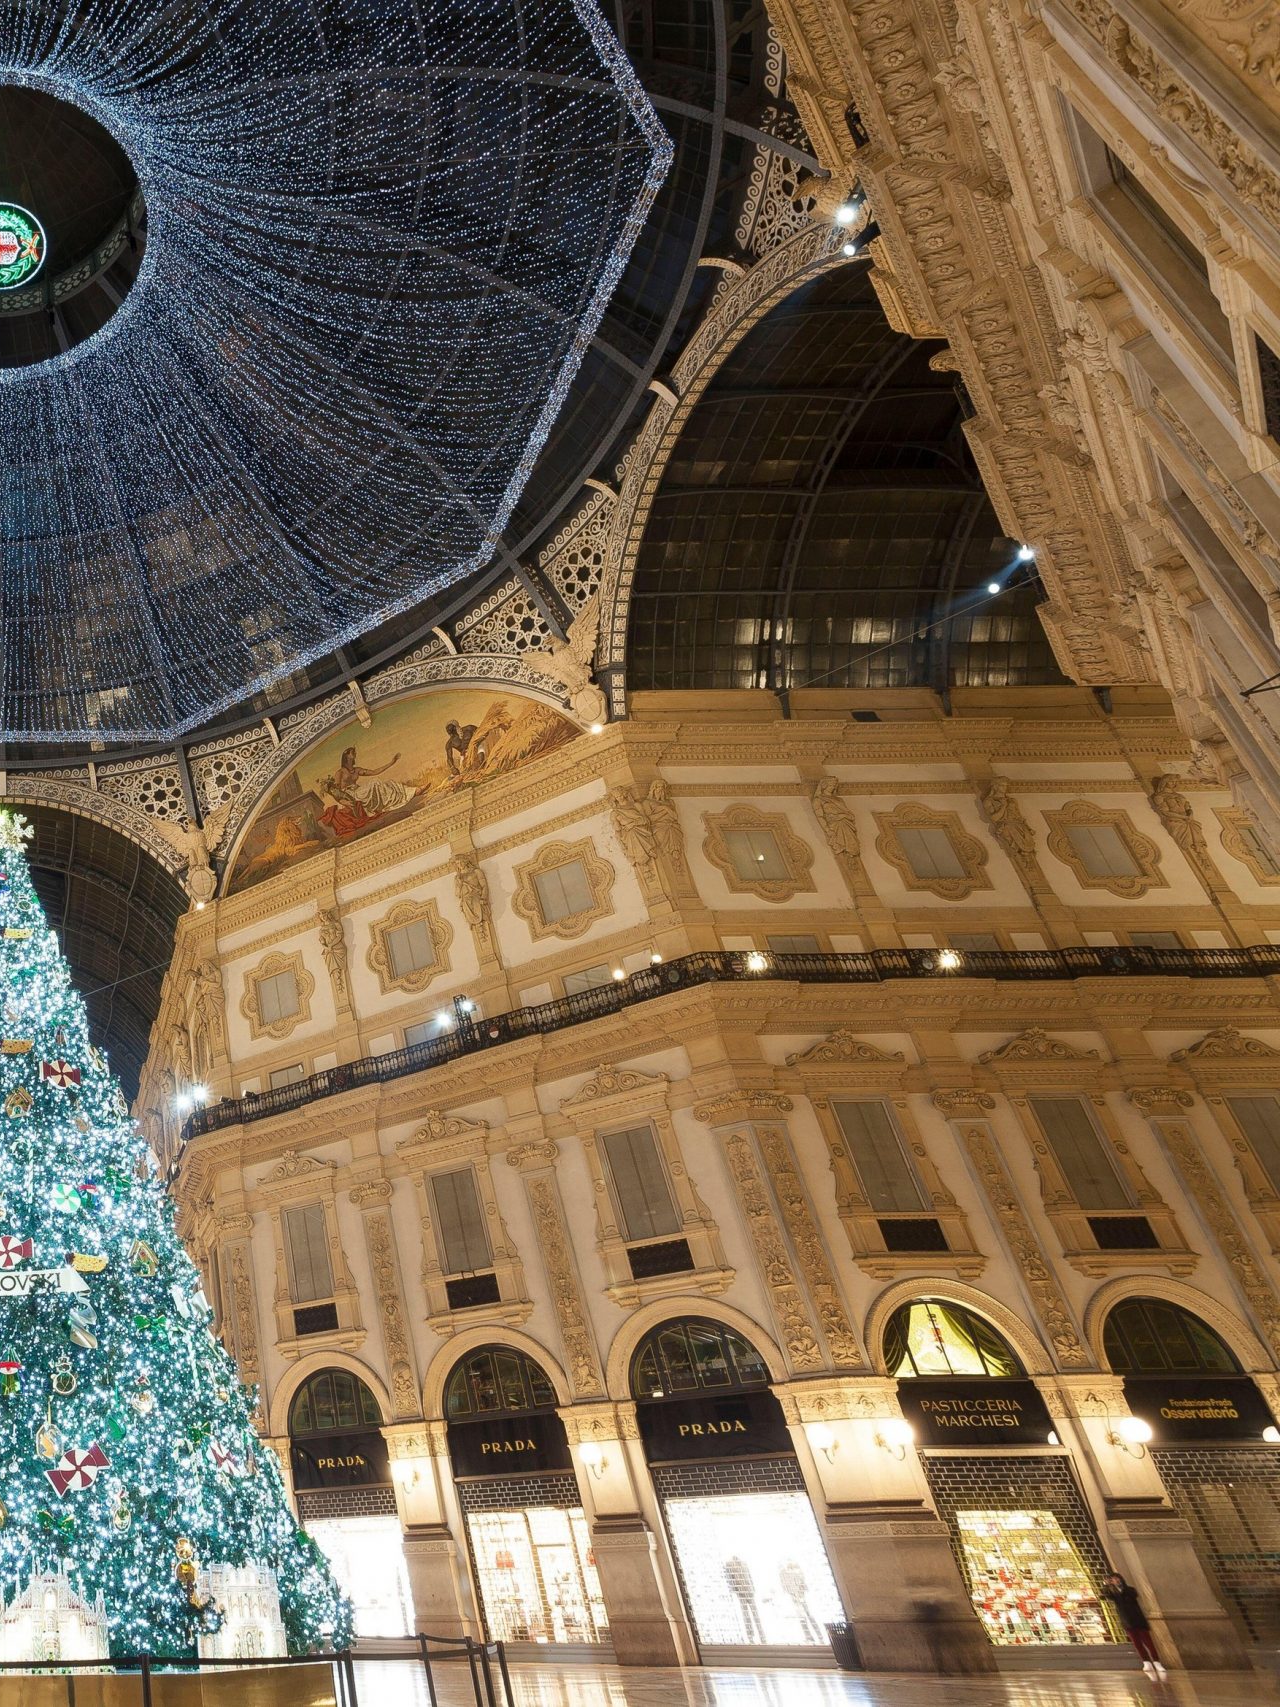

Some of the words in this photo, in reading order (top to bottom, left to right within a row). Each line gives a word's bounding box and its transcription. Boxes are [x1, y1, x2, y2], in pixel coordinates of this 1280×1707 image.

[920, 1399, 1023, 1412] PASTICCERIA
[1169, 1398, 1211, 1407] Fondazione
[1210, 1398, 1233, 1407] Prada
[1160, 1407, 1239, 1419] Osservatorio
[935, 1415, 1020, 1427] MARCHESI
[677, 1420, 747, 1436] PRADA
[481, 1439, 537, 1454] PRADA
[318, 1455, 365, 1469] PRADA
